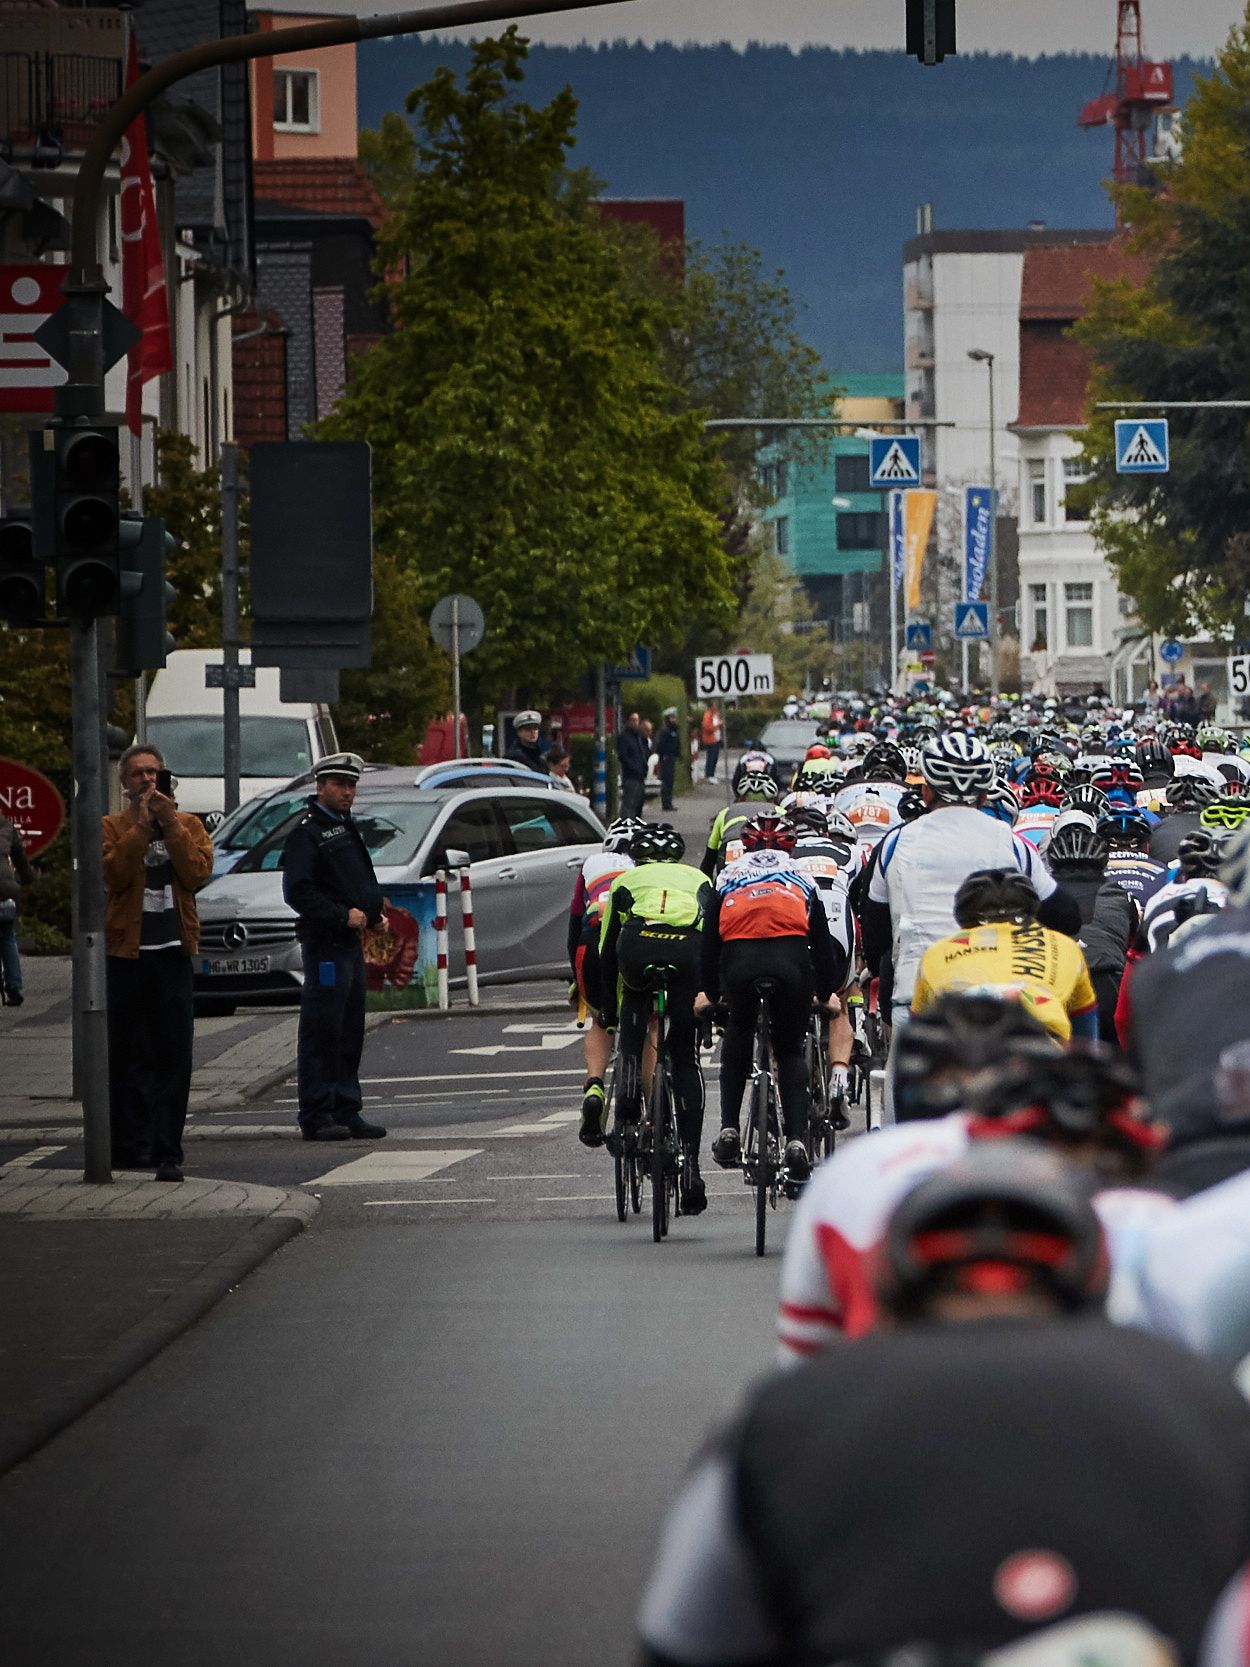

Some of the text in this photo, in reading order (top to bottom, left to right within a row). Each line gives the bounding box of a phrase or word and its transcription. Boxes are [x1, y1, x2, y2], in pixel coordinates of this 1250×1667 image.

[857, 806, 881, 817] 1787
[639, 931, 687, 941] SCOTT
[944, 946, 998, 963] HANSEN
